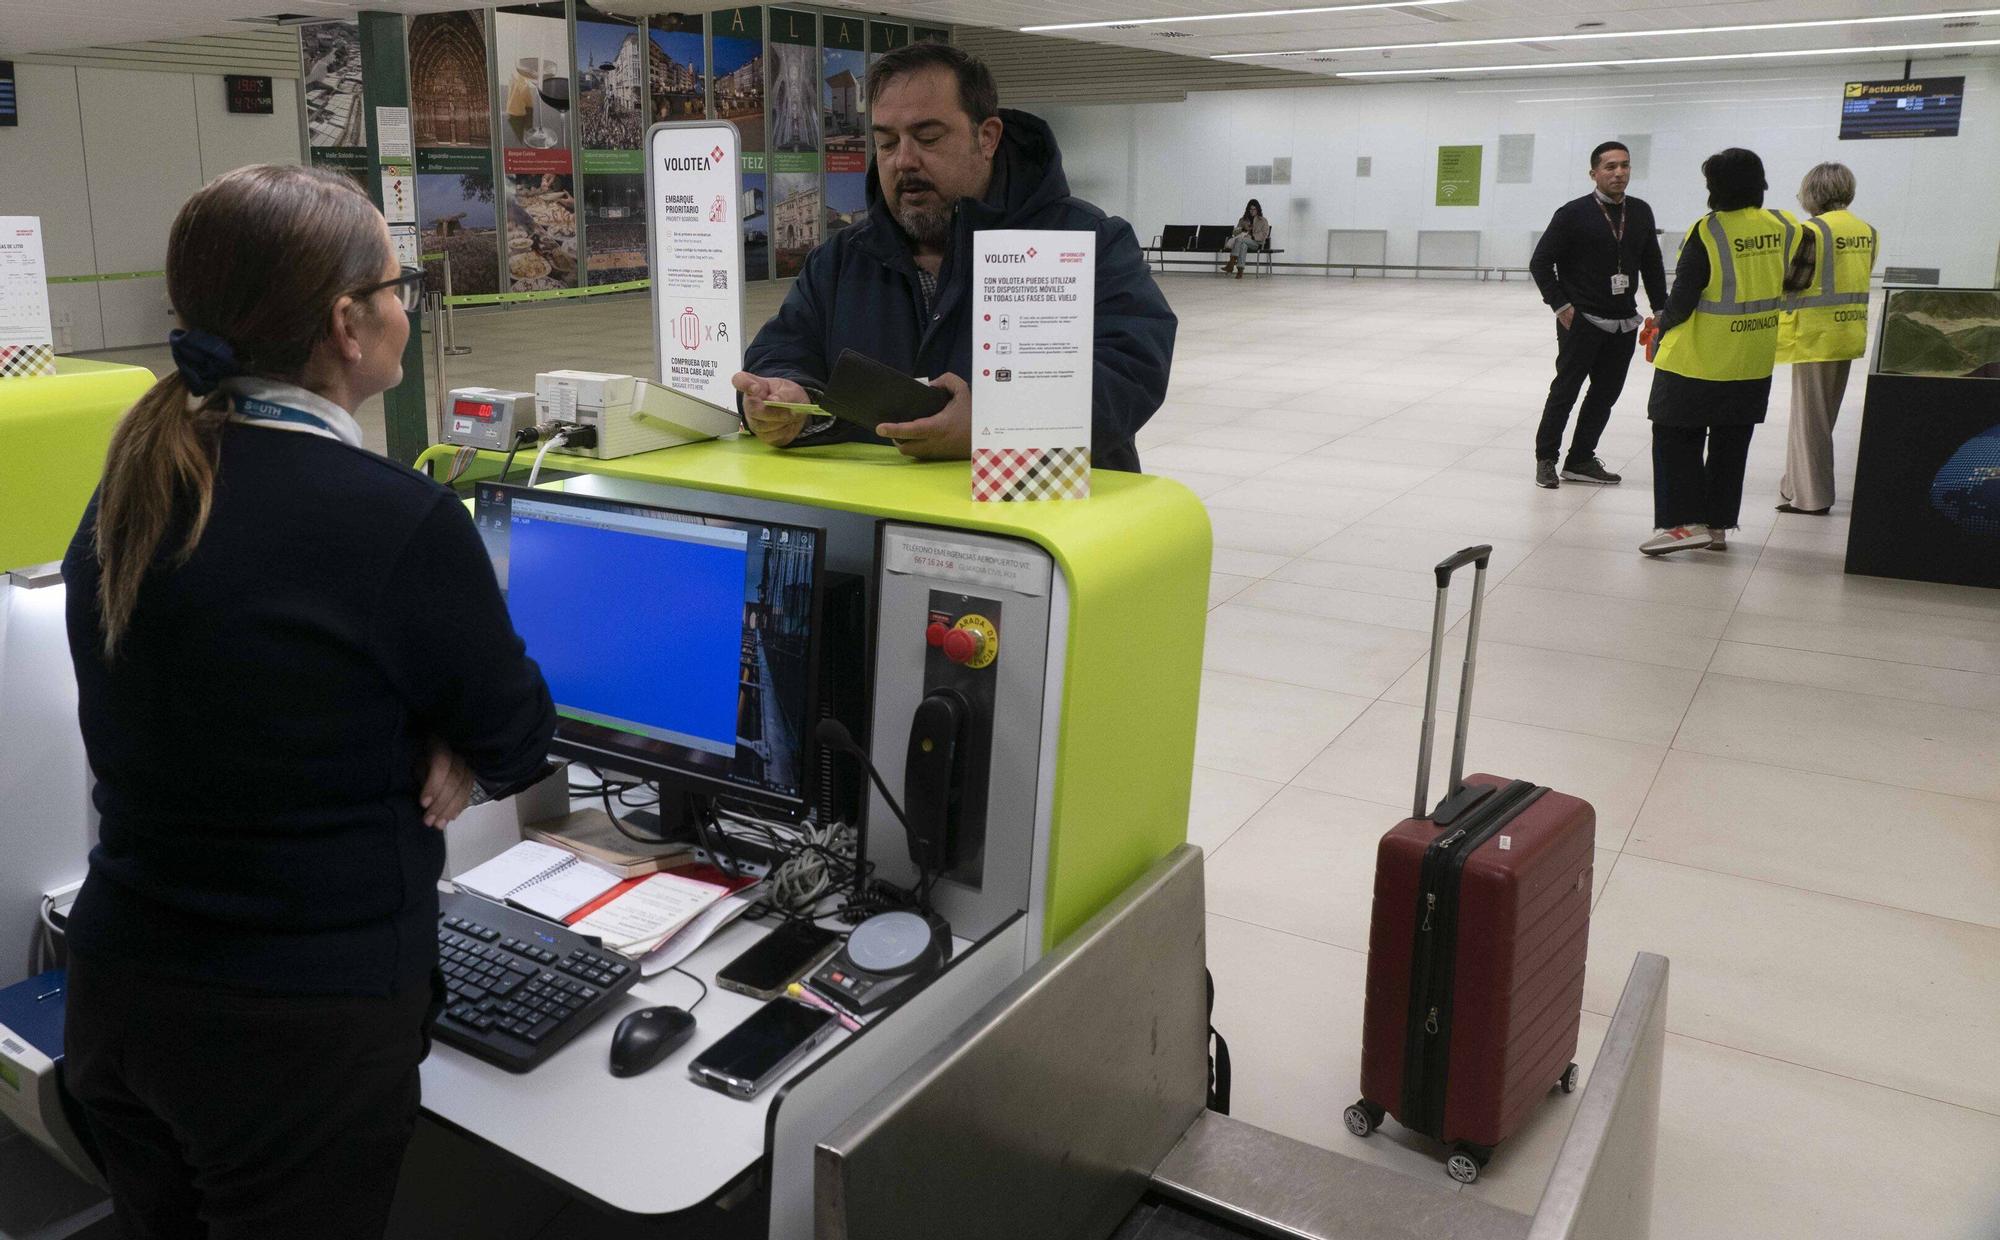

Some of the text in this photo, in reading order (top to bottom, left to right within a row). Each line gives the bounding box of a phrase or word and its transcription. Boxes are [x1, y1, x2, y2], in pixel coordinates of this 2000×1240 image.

[1862, 84, 1922, 94] Facturación
[664, 157, 711, 172] VOLOTEA
[665, 195, 694, 205] EMBARQUE
[665, 205, 699, 214] PRIORITARIO
[1734, 233, 1781, 252] SOUTH
[985, 254, 1026, 263] VOLOTEA
[984, 277, 997, 285] CON
[998, 277, 1024, 285] VOLOTEA
[1026, 277, 1049, 285] PUEDES
[1039, 285, 1065, 293] MÓVILES
[671, 357, 718, 368] COMPRUEBA QUE TU
[671, 366, 689, 374] MALETA
[690, 368, 702, 376] CABE
[903, 543, 933, 554] TELÉFONO
[933, 548, 977, 561] EMERGENCIAS
[977, 554, 1018, 567] AEROPUERTO
[936, 559, 944, 567] 24
[958, 617, 986, 630] ARADA
[987, 629, 996, 642] DE
